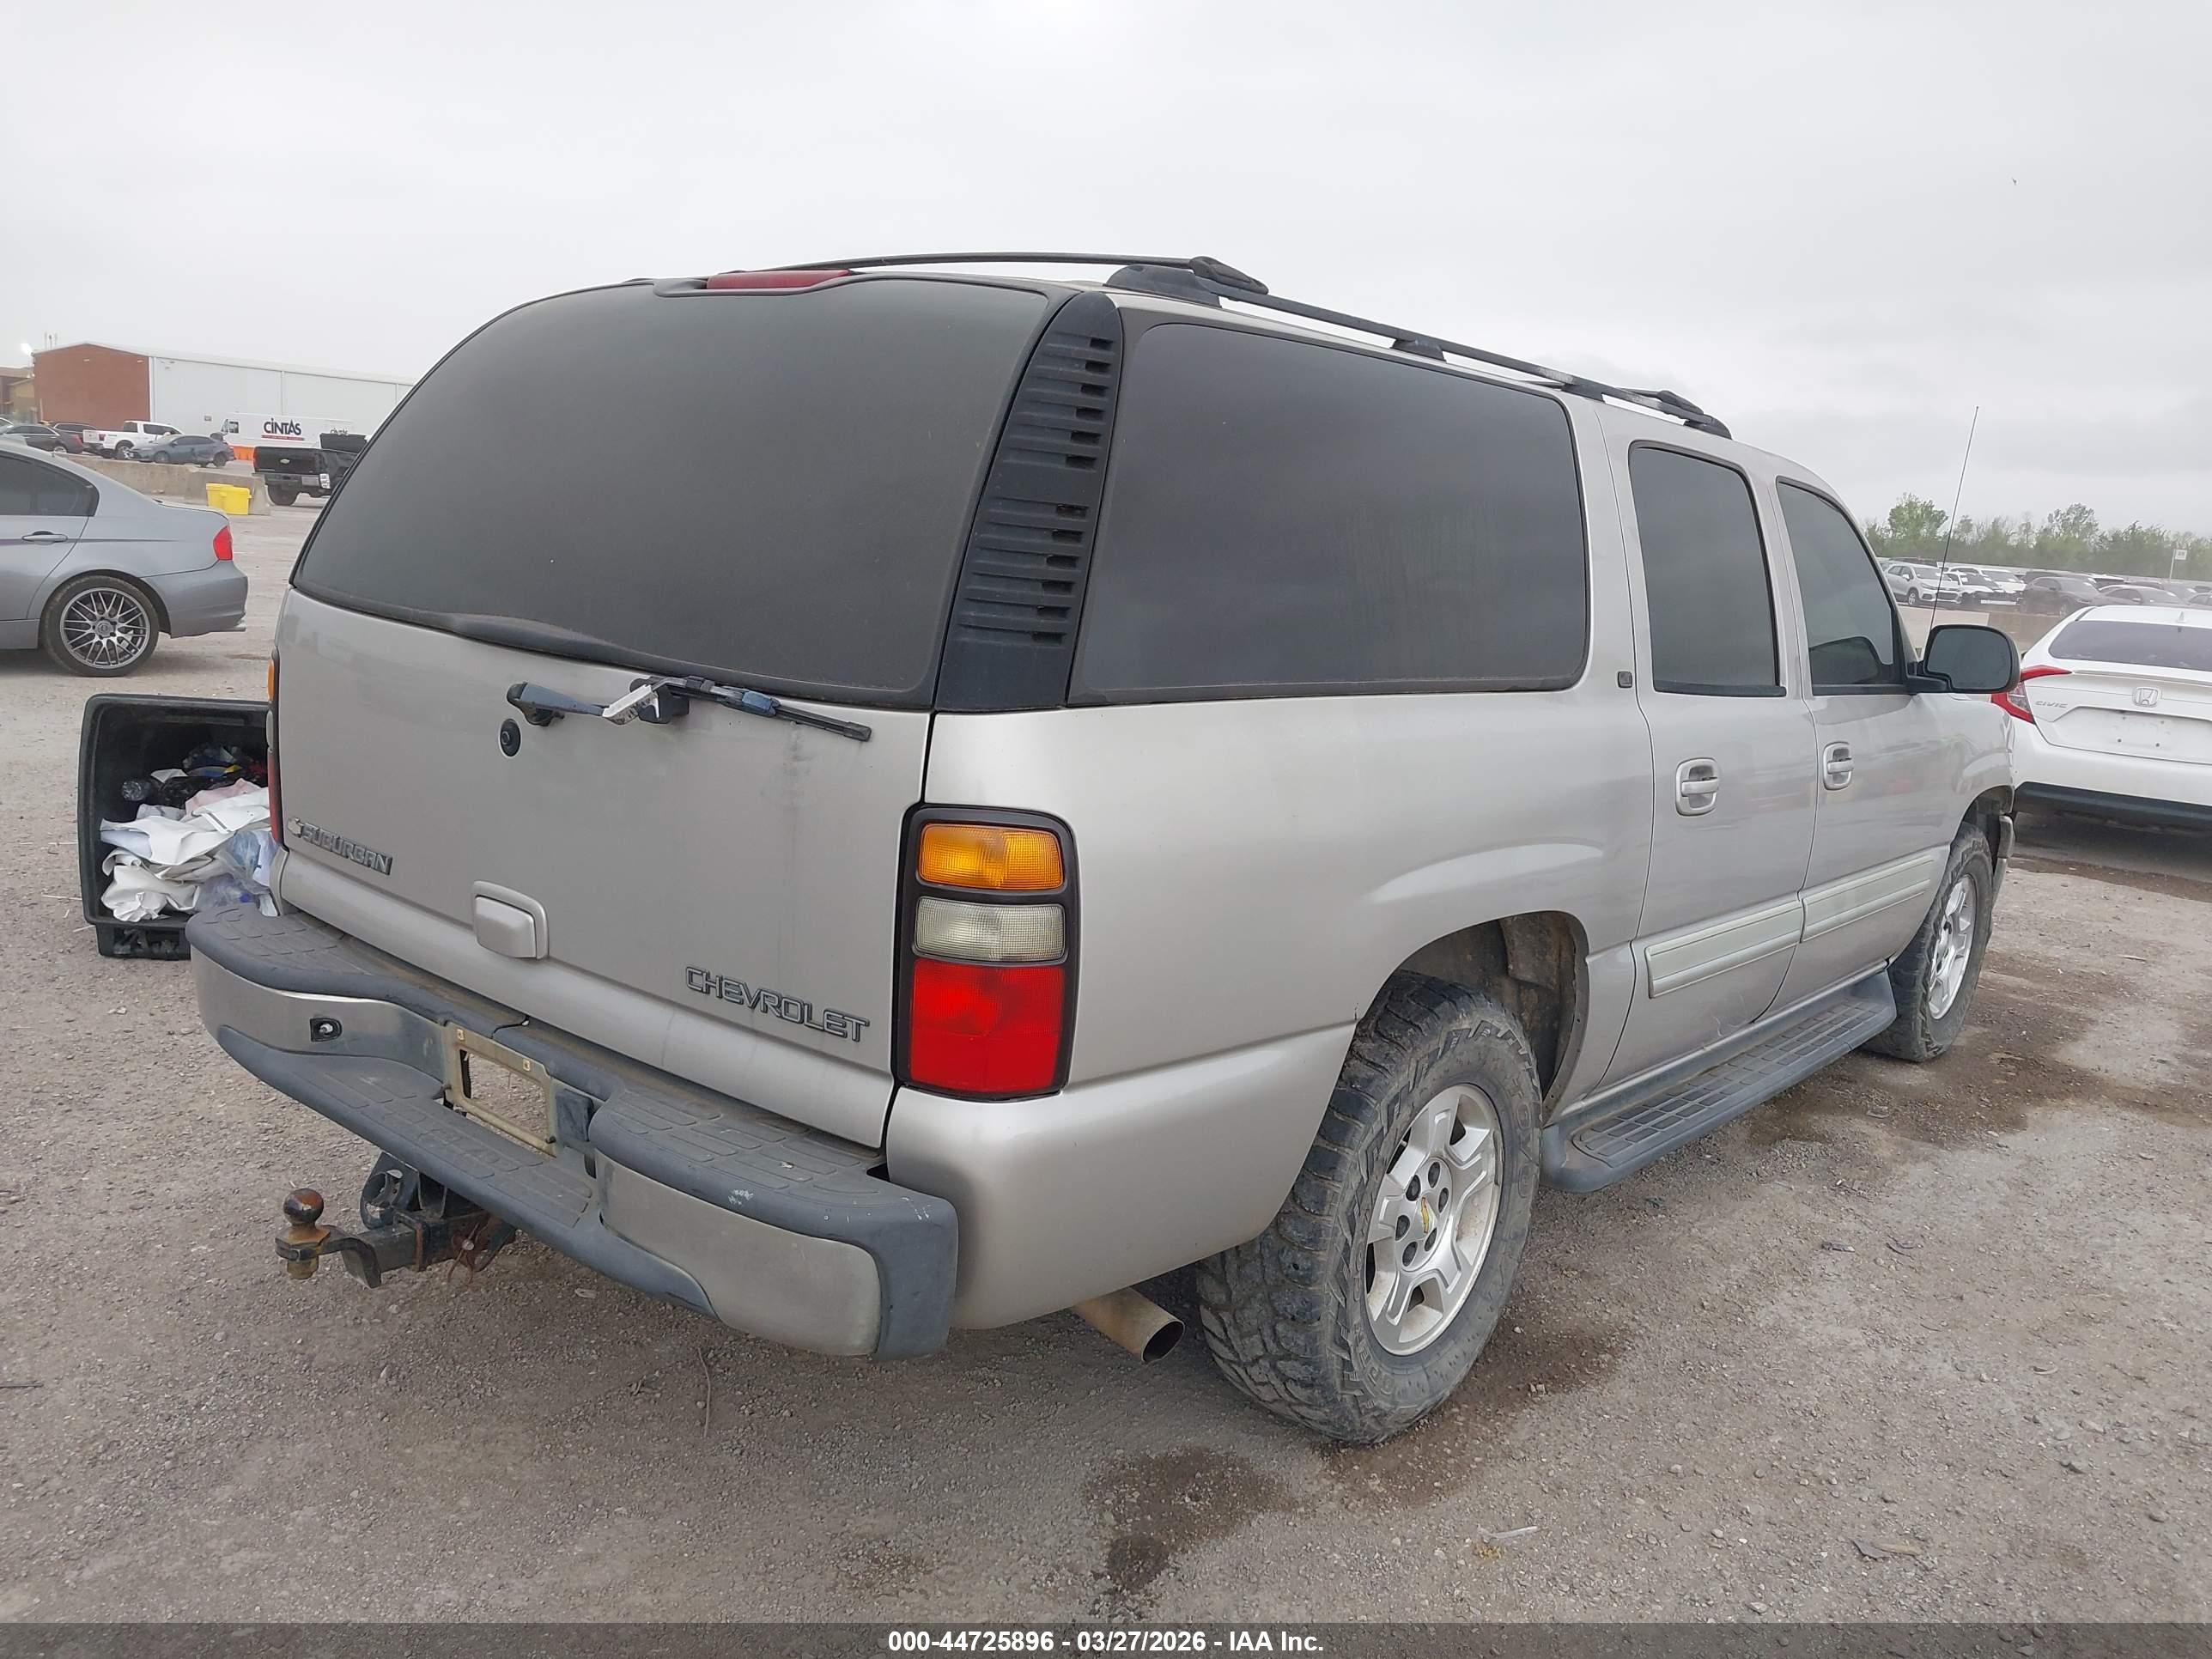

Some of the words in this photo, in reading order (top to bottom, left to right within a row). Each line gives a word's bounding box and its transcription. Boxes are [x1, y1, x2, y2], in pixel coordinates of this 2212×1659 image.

[2034, 700, 2069, 708] CIVIC
[302, 822, 393, 876] SUBURBAN
[686, 966, 870, 1042] CHEVROLET
